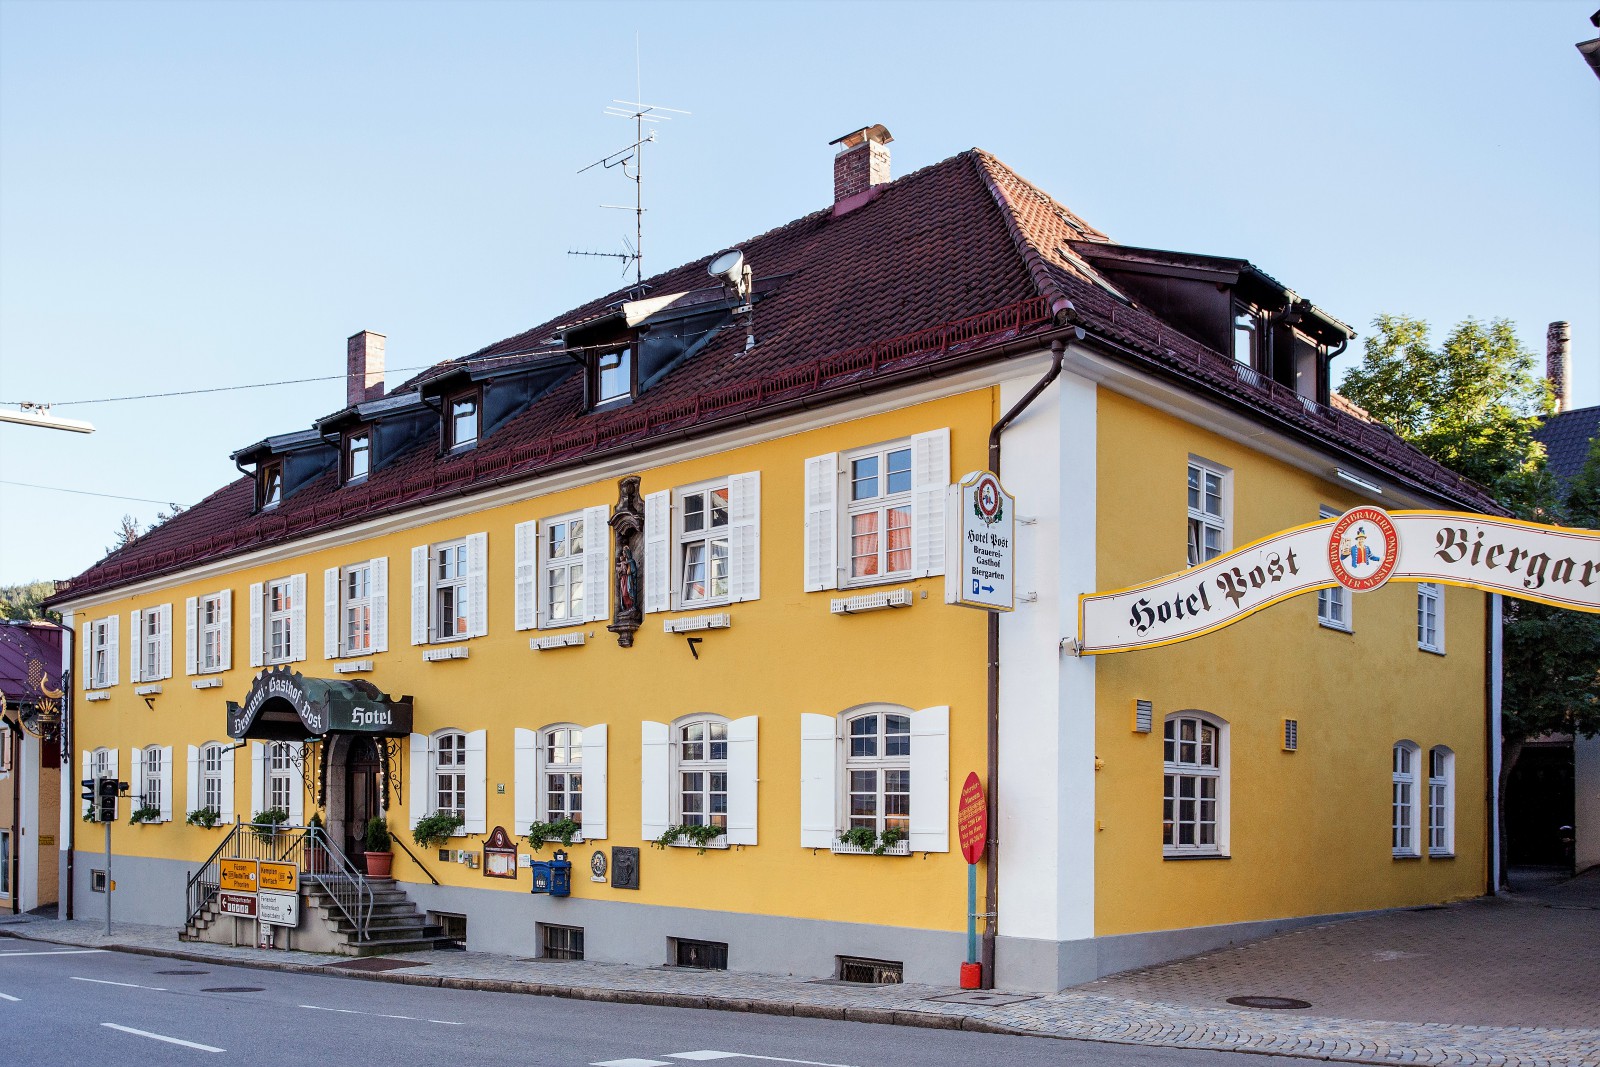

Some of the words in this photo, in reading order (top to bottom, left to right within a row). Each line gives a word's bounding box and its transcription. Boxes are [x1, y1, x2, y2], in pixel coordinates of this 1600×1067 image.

[1333, 511, 1393, 540] POSTBRAUEREI
[967, 529, 989, 544] Hotel
[990, 533, 1009, 549] Post
[973, 545, 1003, 558] Brauerei-
[976, 556, 1001, 568] Gasthof
[1330, 542, 1339, 564] KARL
[1363, 536, 1396, 588] NESSELWANG
[971, 566, 1005, 580] Biergarten
[1334, 565, 1361, 588] MEYER
[1129, 580, 1213, 638] Hotel
[1216, 546, 1300, 609] Post
[268, 677, 303, 704] Gasthof
[301, 702, 322, 729] Post
[351, 707, 393, 726] Hotel
